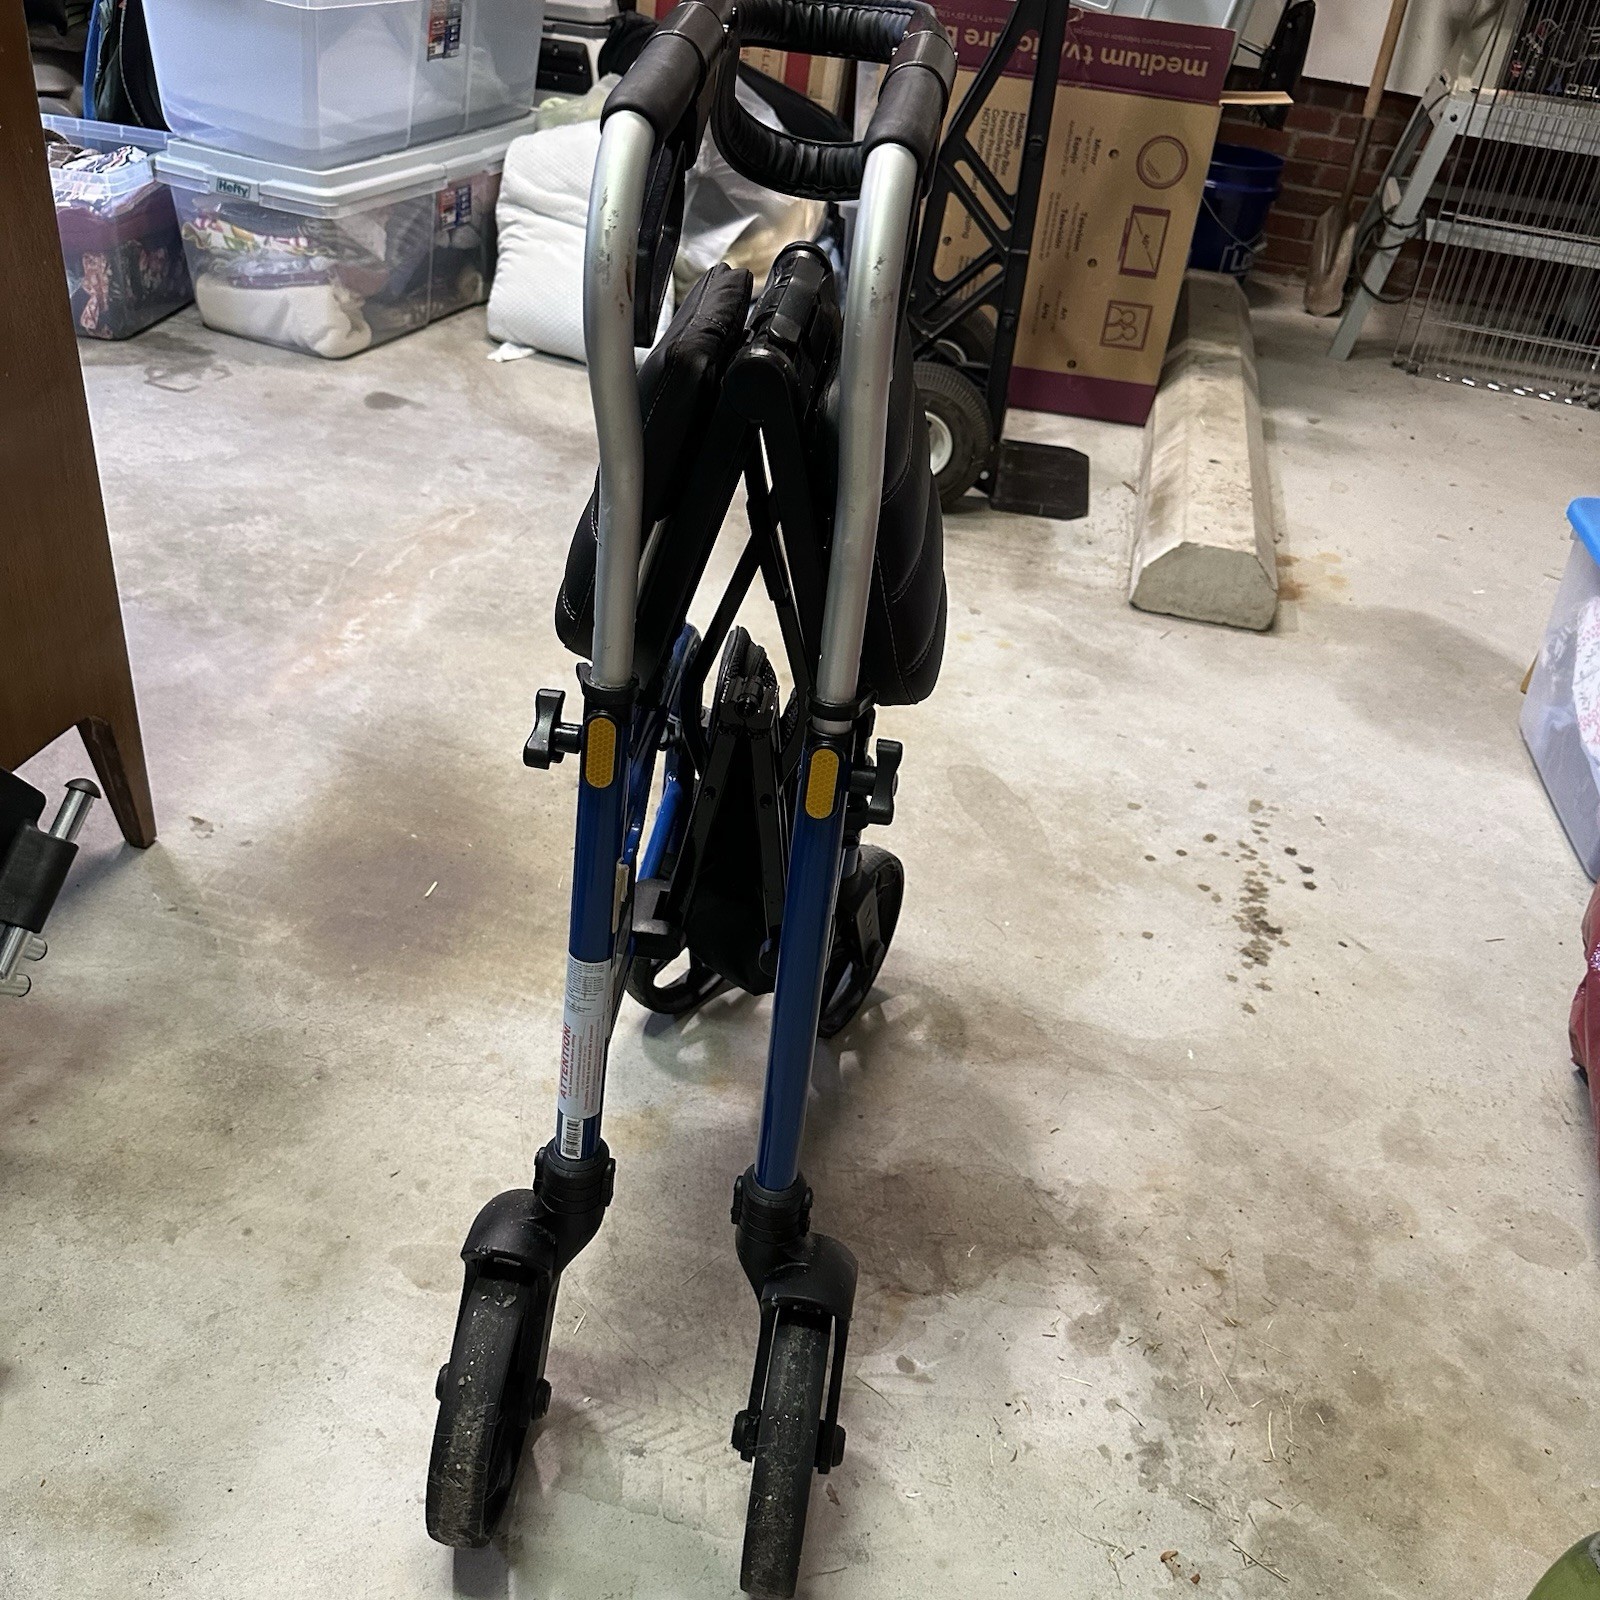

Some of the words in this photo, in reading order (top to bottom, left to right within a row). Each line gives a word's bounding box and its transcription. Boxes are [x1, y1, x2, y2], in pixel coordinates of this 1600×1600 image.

[1100, 47, 1209, 79] medium
[1564, 82, 1600, 99] DEL
[981, 108, 992, 126] NOT
[1090, 138, 1102, 166] Mirror
[219, 180, 248, 198] Hefty
[560, 1022, 571, 1100] ATTENTION!
